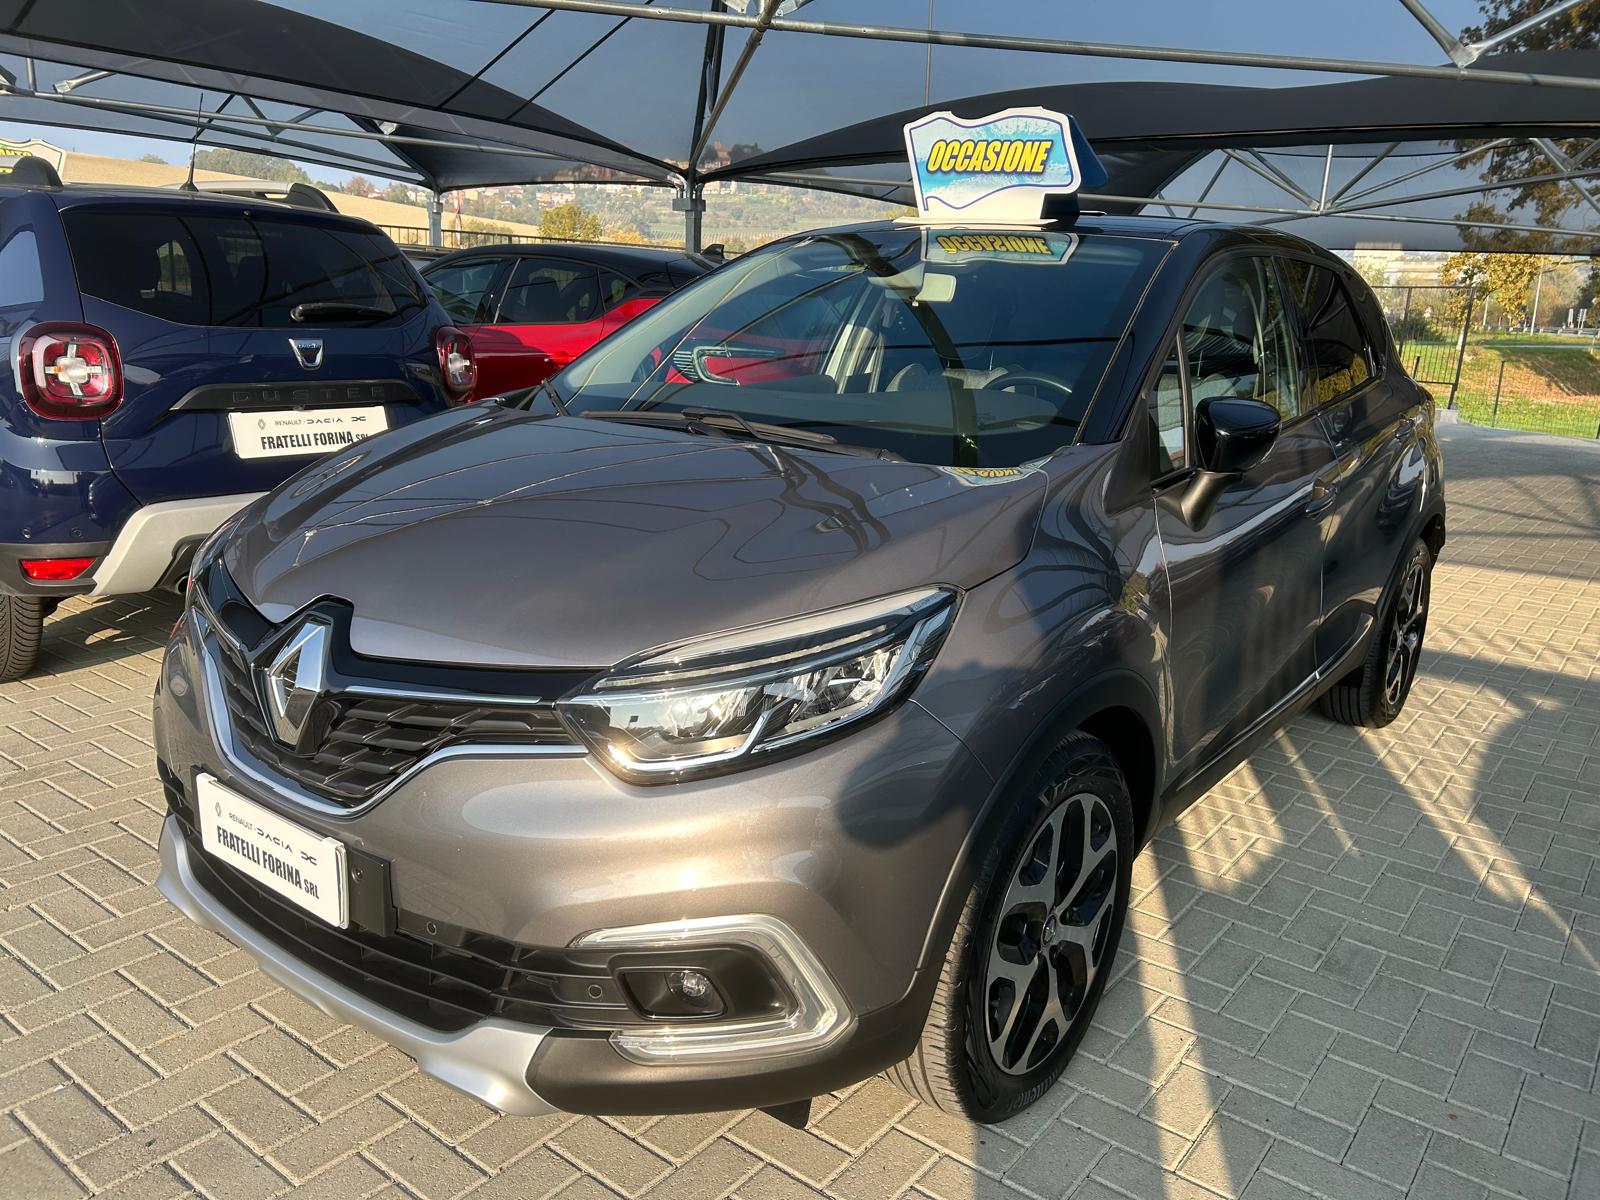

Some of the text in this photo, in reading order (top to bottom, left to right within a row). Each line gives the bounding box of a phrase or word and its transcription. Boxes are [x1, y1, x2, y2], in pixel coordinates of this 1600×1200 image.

[926, 139, 1053, 174] OCCASIONE
[232, 386, 385, 402] DUSTER
[274, 418, 302, 427] RENAULT
[306, 417, 344, 425] DACIA
[260, 432, 312, 450] FRATELLI
[313, 431, 354, 446] FORINA
[228, 812, 254, 831] RENAULT
[257, 827, 294, 854] DACIA
[216, 825, 320, 900] FRATELLI FORINA SRL
